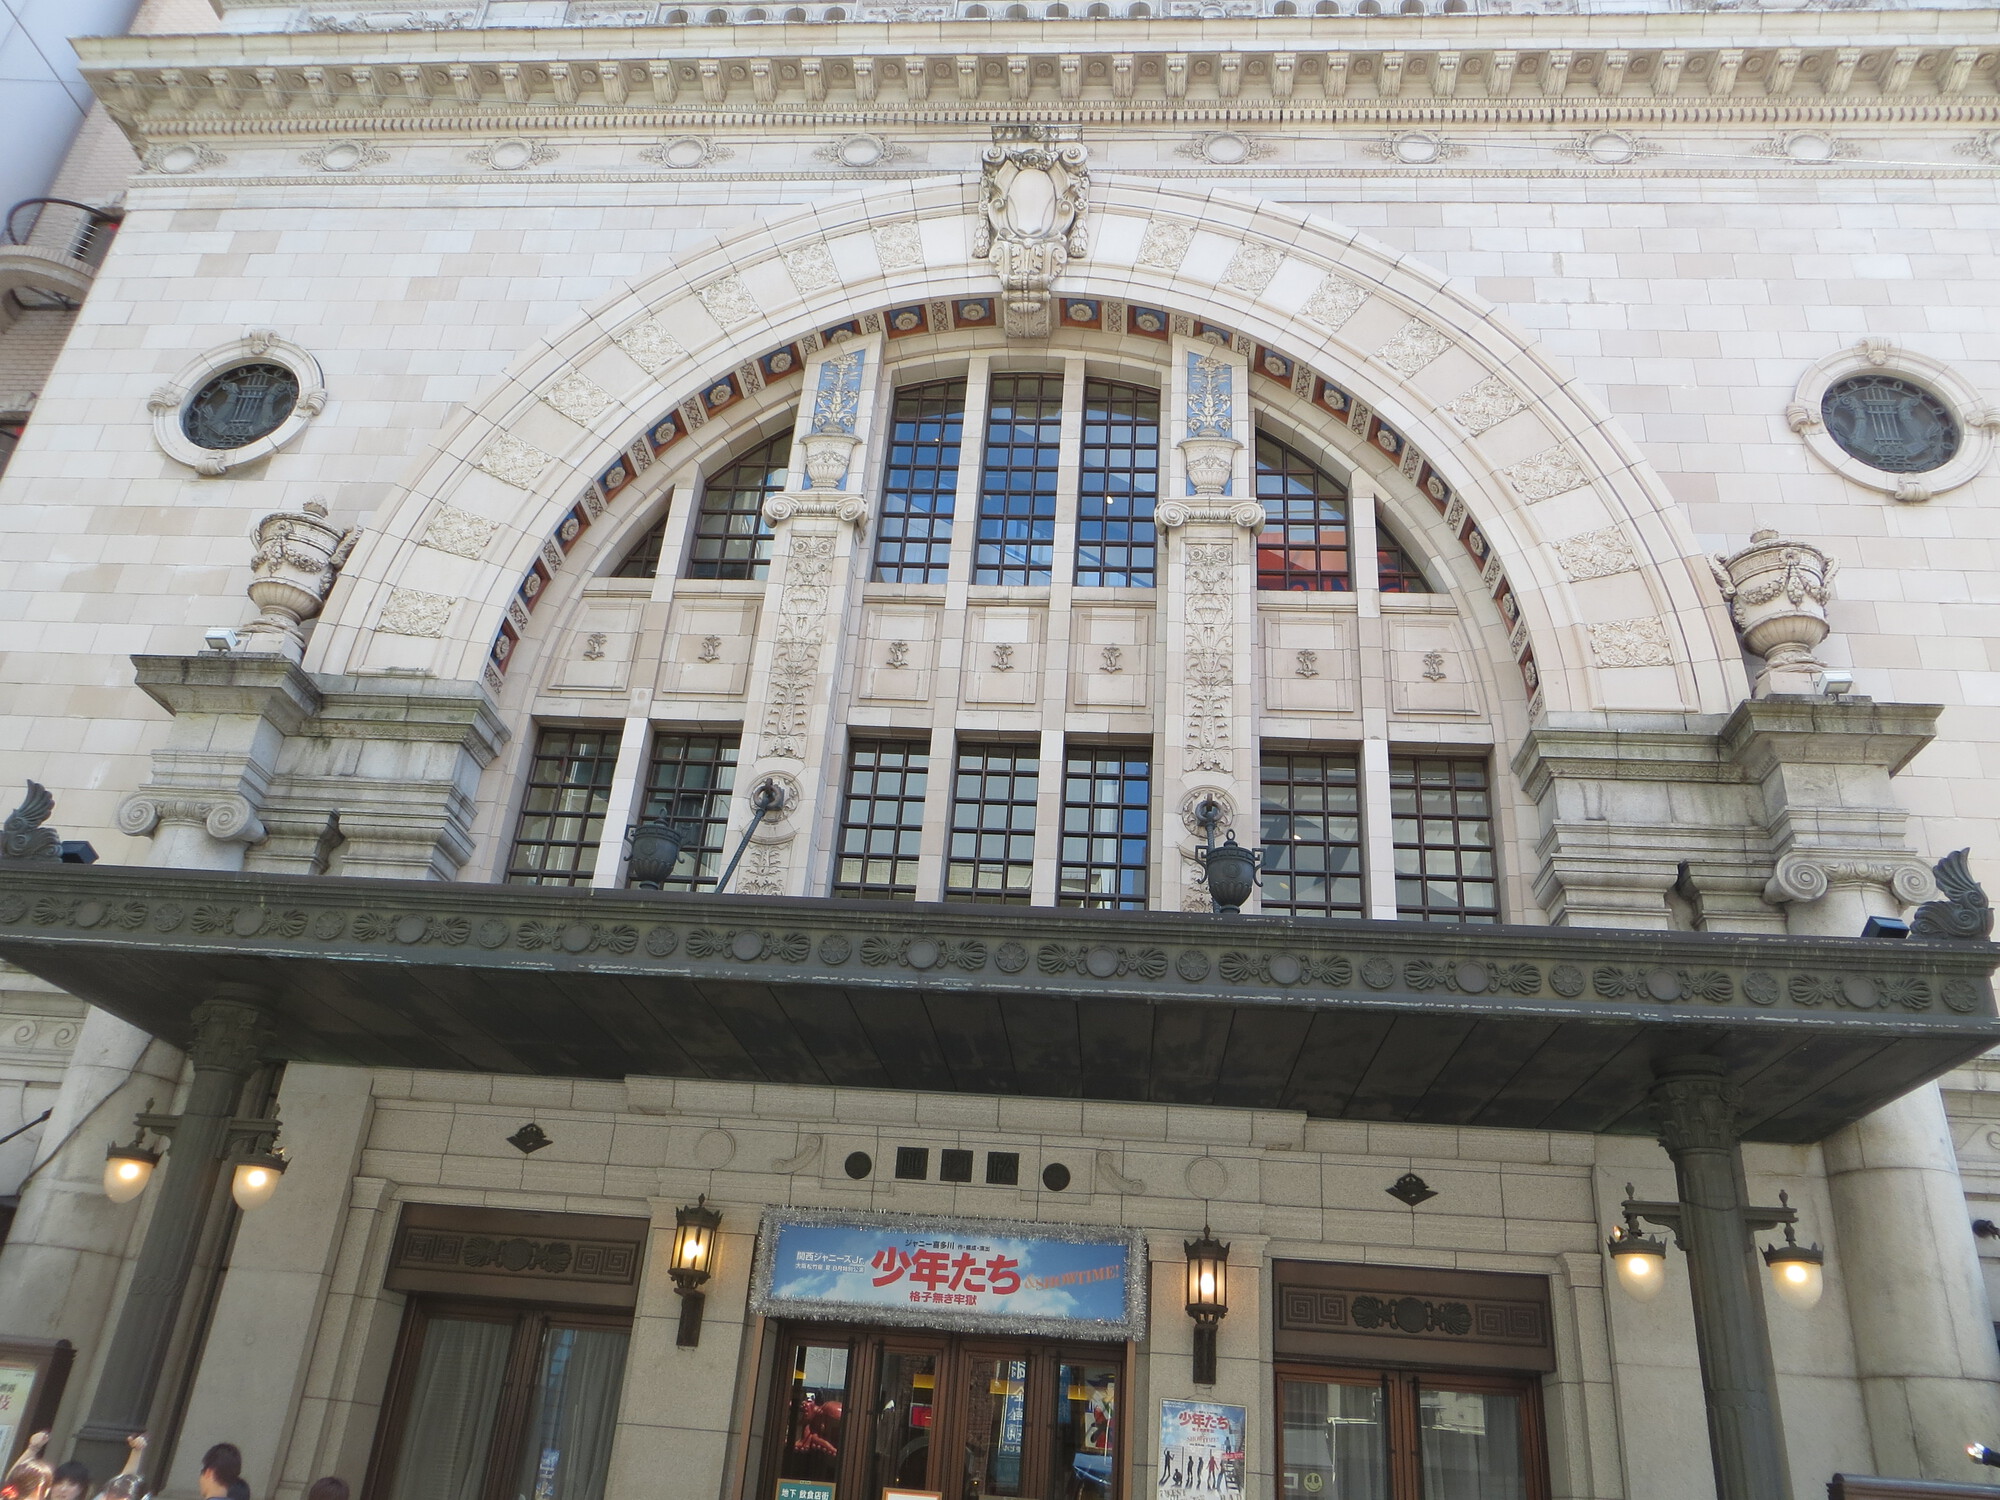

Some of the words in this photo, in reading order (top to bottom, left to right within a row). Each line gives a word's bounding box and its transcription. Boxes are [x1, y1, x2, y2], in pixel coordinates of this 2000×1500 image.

[905, 1239, 954, 1250] ジャニー喜多川
[871, 1246, 1021, 1295] 少年たち
[909, 1290, 977, 1306] 格子無き牢獄
[1179, 1412, 1230, 1430] 少年たち
[781, 1488, 796, 1498] 地下
[799, 1490, 830, 1500] 飲食店街
